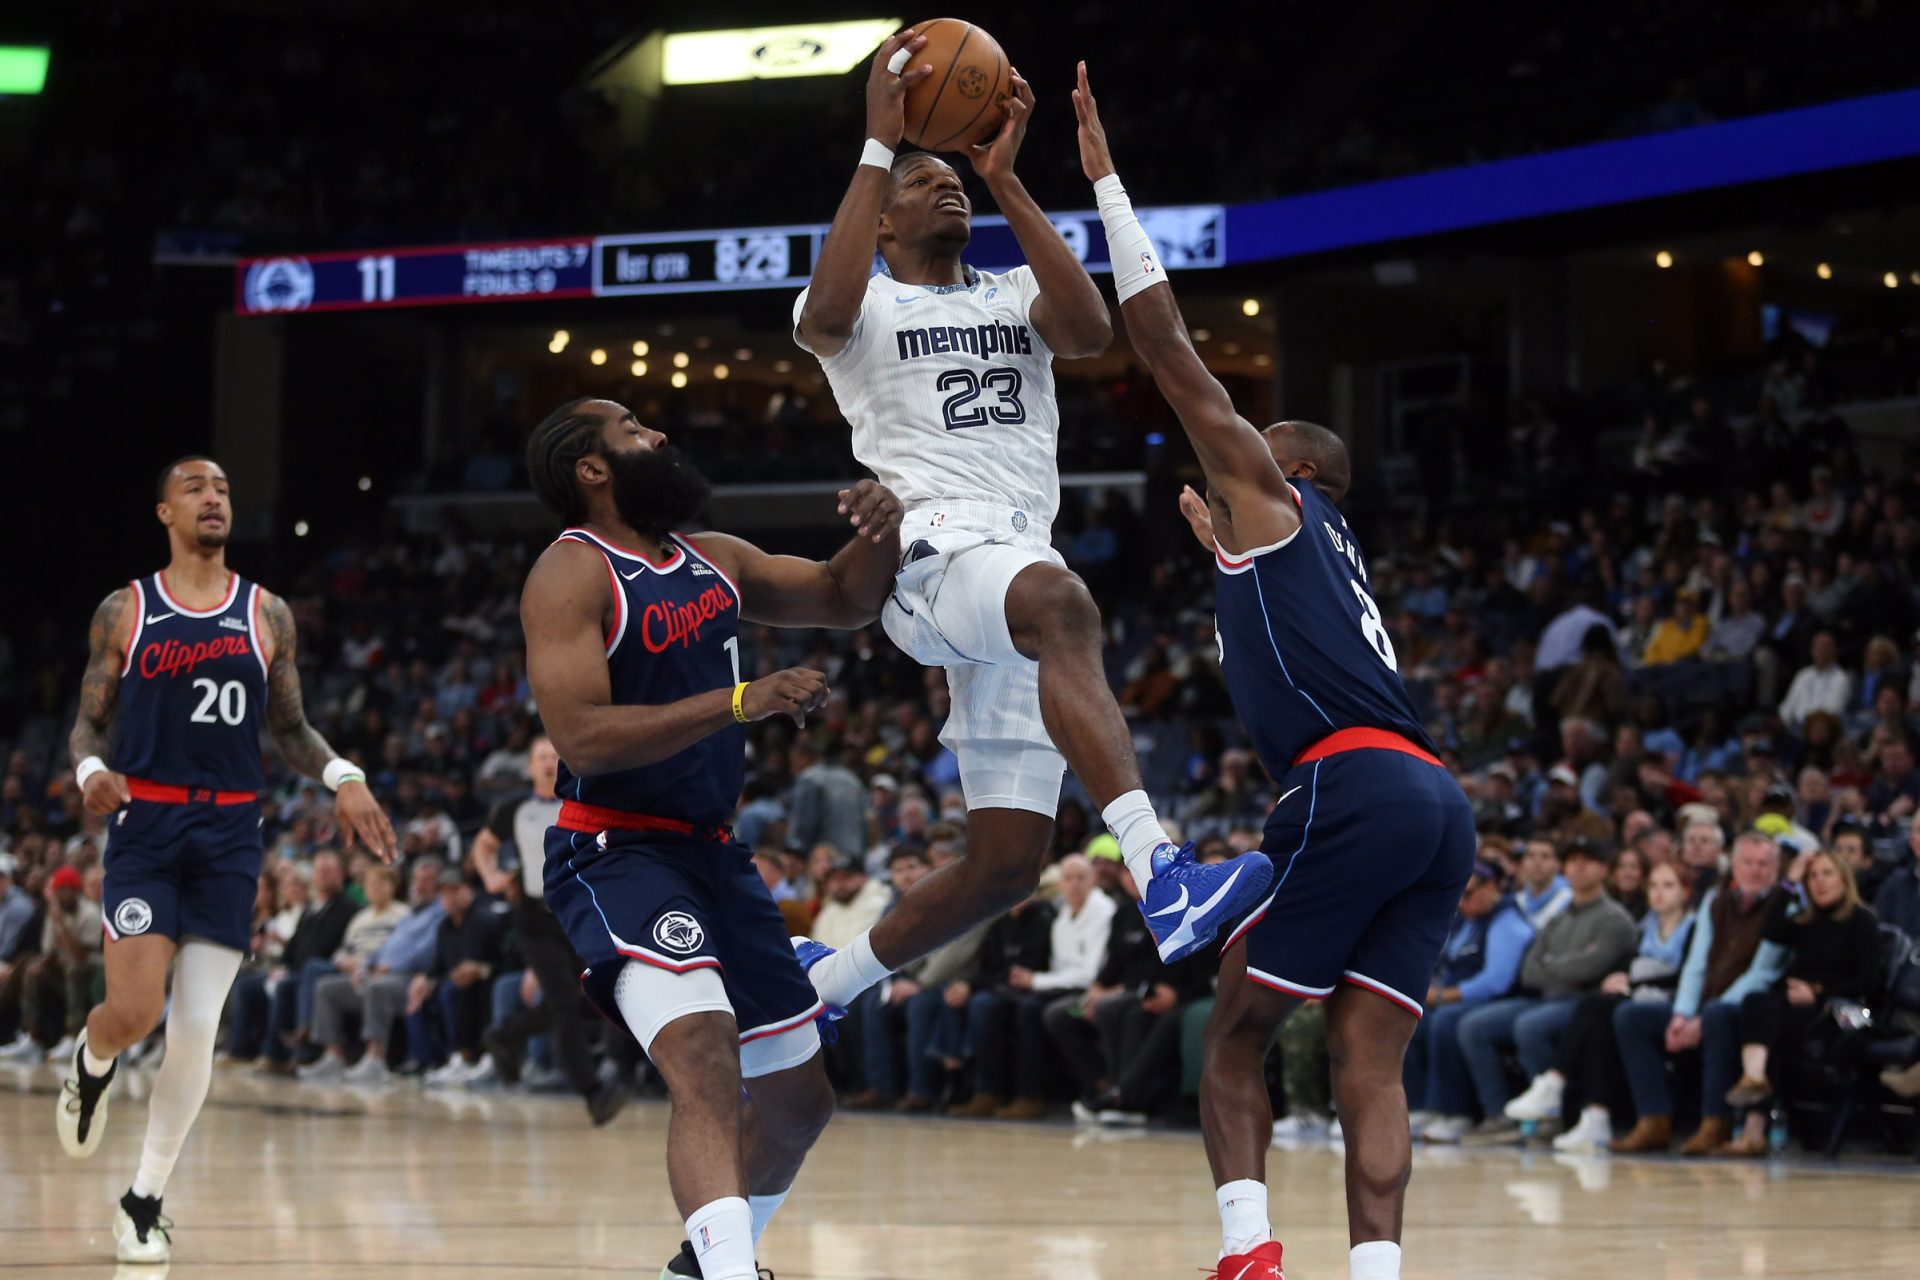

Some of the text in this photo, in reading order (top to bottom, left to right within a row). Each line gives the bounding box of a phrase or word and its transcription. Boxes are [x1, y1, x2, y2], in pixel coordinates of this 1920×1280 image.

[357, 255, 396, 302] 11
[715, 234, 791, 283] 8:29
[896, 319, 1032, 361] memphis
[936, 367, 1026, 431] 23
[642, 582, 734, 654] Clippers
[1350, 578, 1397, 674] 8
[140, 634, 250, 679] Clippers
[723, 635, 740, 686] 1
[190, 677, 247, 726] 20
